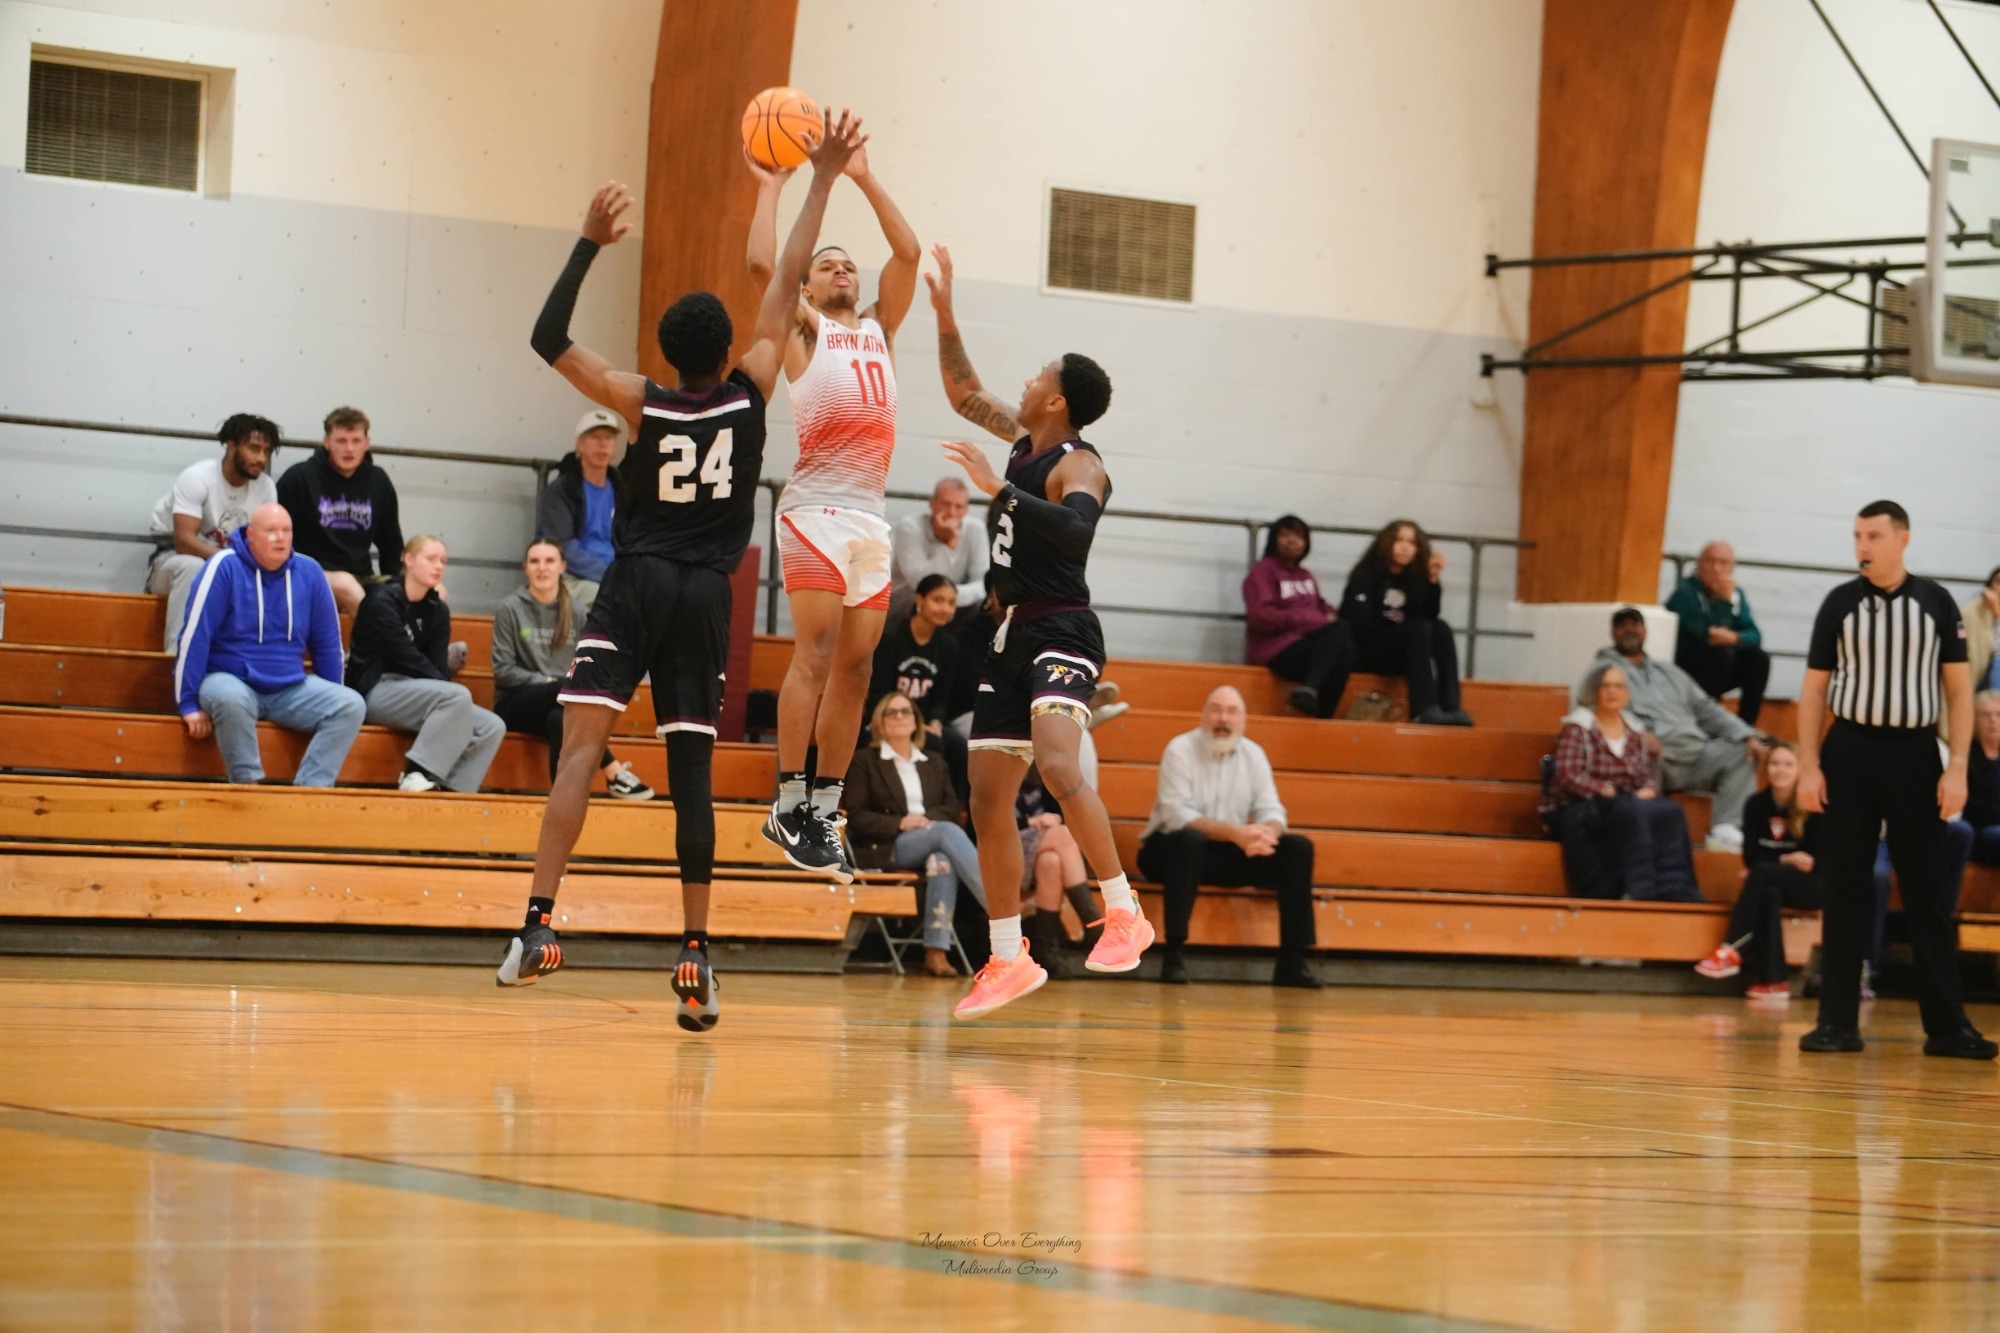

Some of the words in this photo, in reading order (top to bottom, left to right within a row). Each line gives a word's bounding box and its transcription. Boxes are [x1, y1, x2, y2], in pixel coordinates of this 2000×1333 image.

[826, 333, 859, 351] BRYN
[851, 359, 887, 408] 10
[659, 428, 733, 503] 24
[991, 513, 1014, 568] 2
